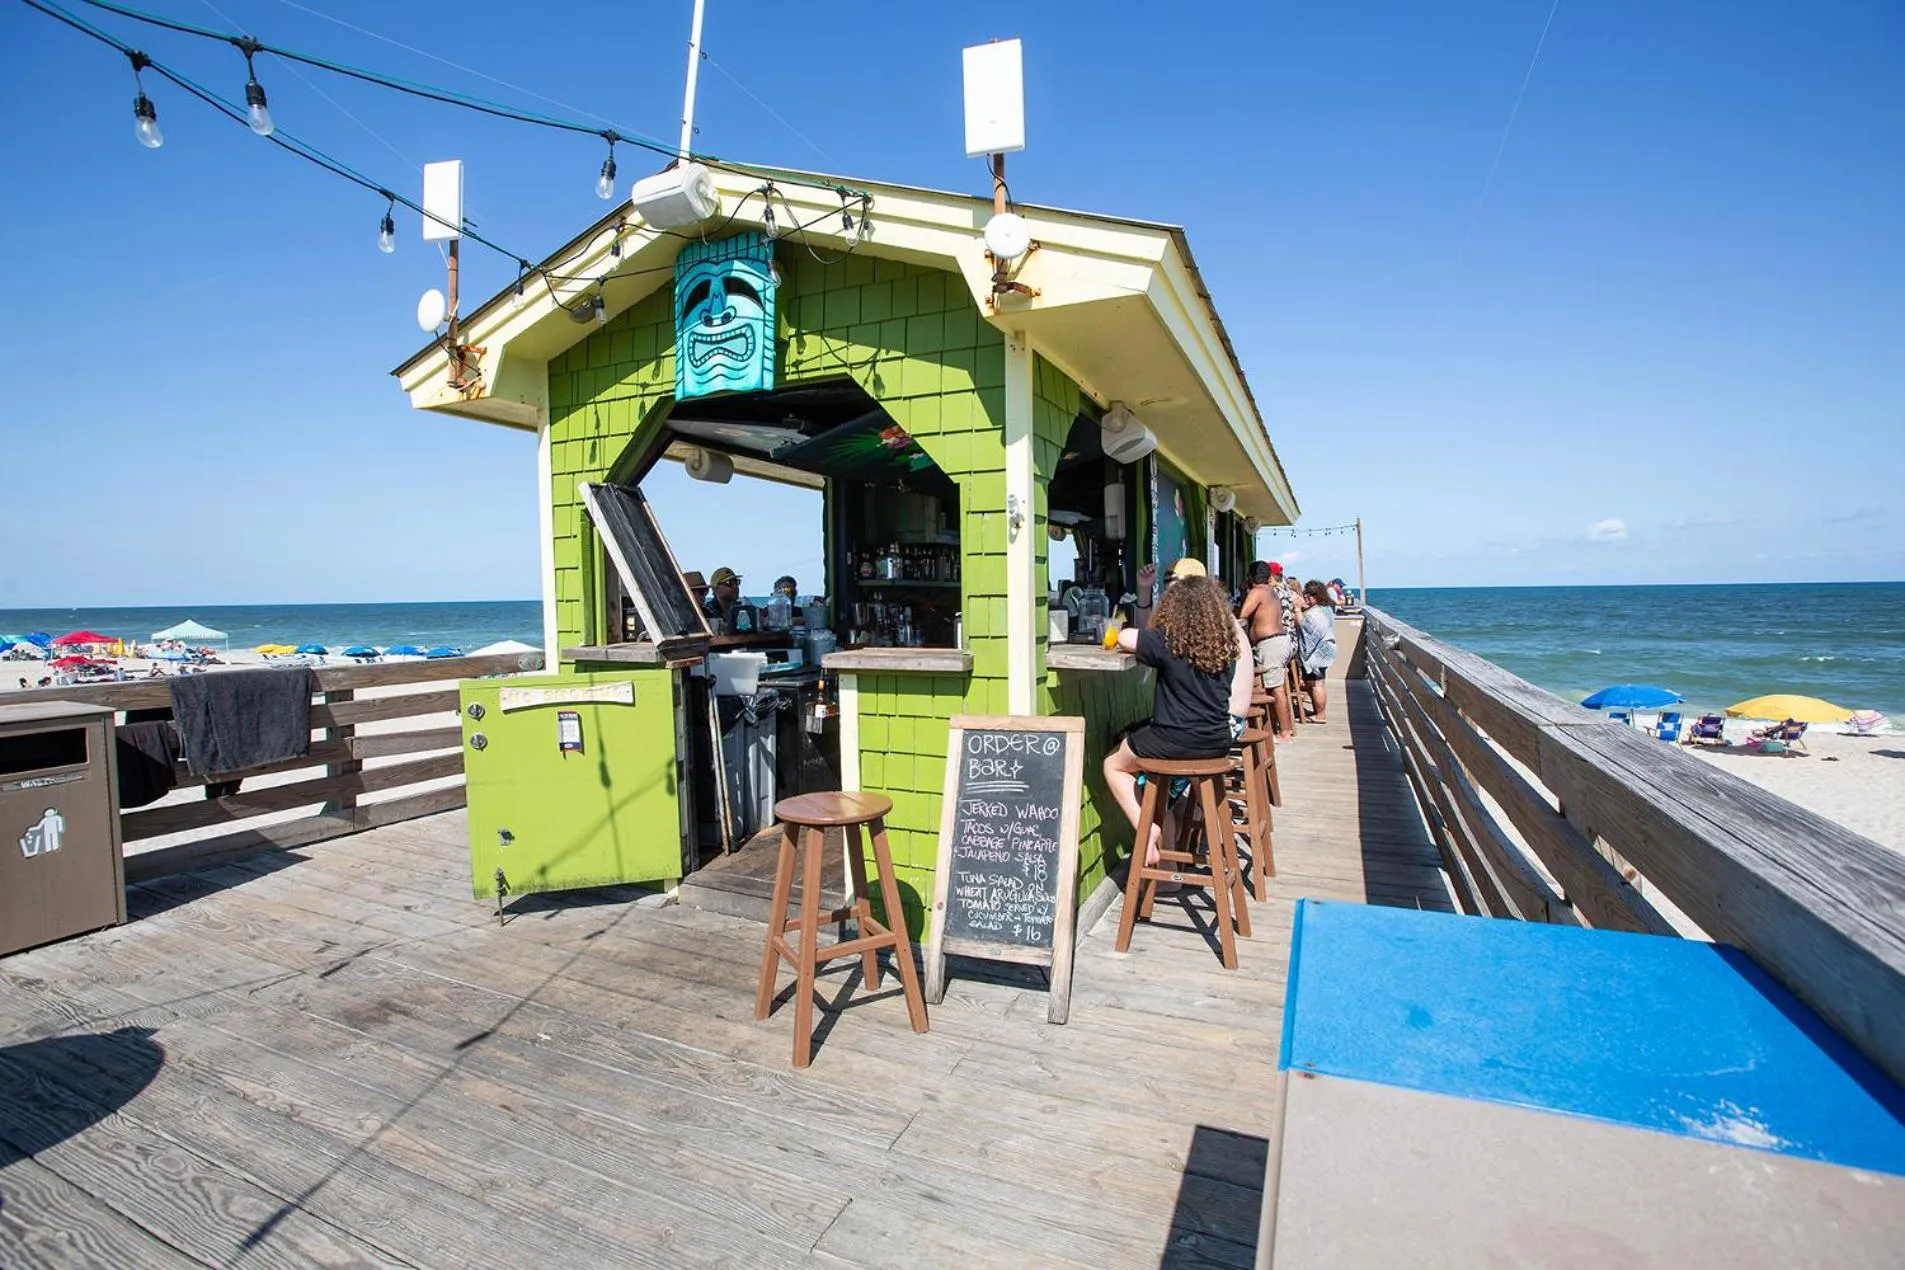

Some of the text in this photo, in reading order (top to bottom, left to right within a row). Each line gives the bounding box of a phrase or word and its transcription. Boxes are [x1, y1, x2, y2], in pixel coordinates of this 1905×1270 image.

[968, 733, 1060, 756] ORDER @
[959, 799, 1059, 821] JERKED WAHOO
[959, 818, 995, 835] TACOS
[957, 871, 987, 885] TUNA
[988, 873, 1024, 890] SALAD
[955, 885, 988, 902] WHEAT
[956, 898, 1002, 912] TOMATO
